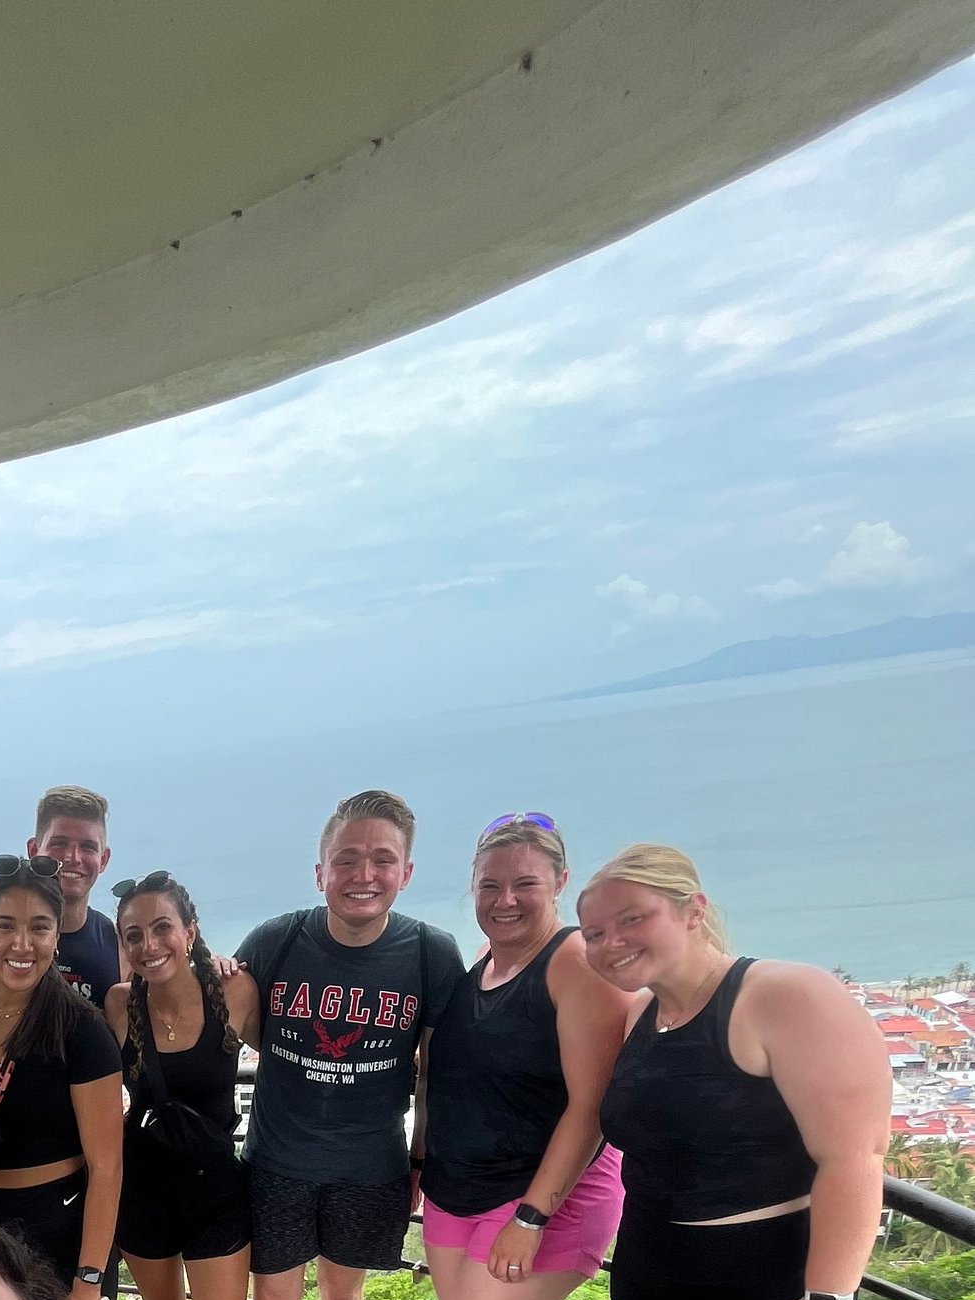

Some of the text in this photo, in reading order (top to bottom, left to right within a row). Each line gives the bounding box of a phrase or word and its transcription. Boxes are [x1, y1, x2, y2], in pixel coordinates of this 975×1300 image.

[270, 982, 418, 1031] EAGLES
[281, 1028, 303, 1043] EST.
[271, 1043, 398, 1073] EASTERN WASHINGTON UNIVERSITY
[306, 1070, 355, 1085] CHENEY, WA
